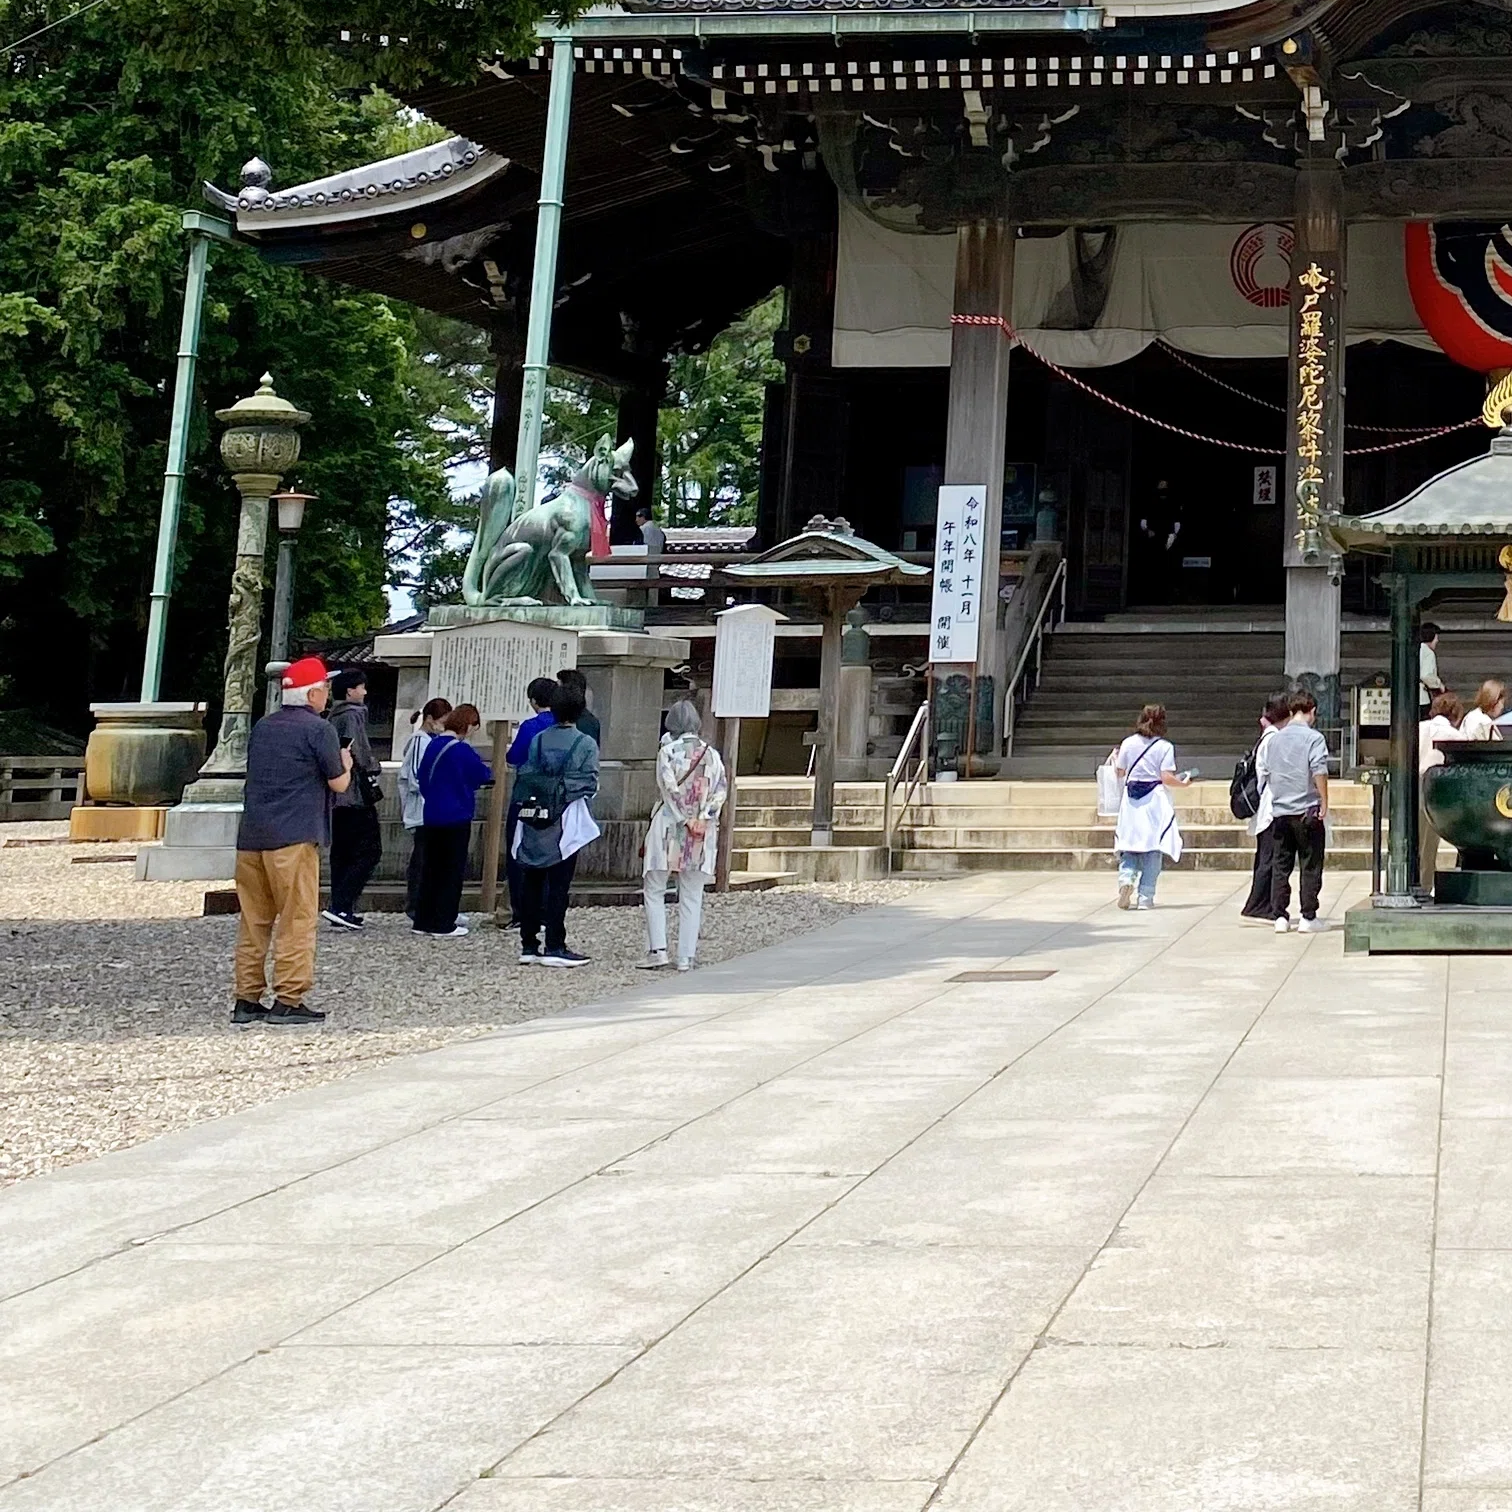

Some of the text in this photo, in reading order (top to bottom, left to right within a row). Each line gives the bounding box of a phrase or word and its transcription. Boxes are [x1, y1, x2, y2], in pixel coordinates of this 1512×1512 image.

[936, 520, 957, 650] 午年開帳 開催
[960, 496, 980, 616] 令和八年 十一月
